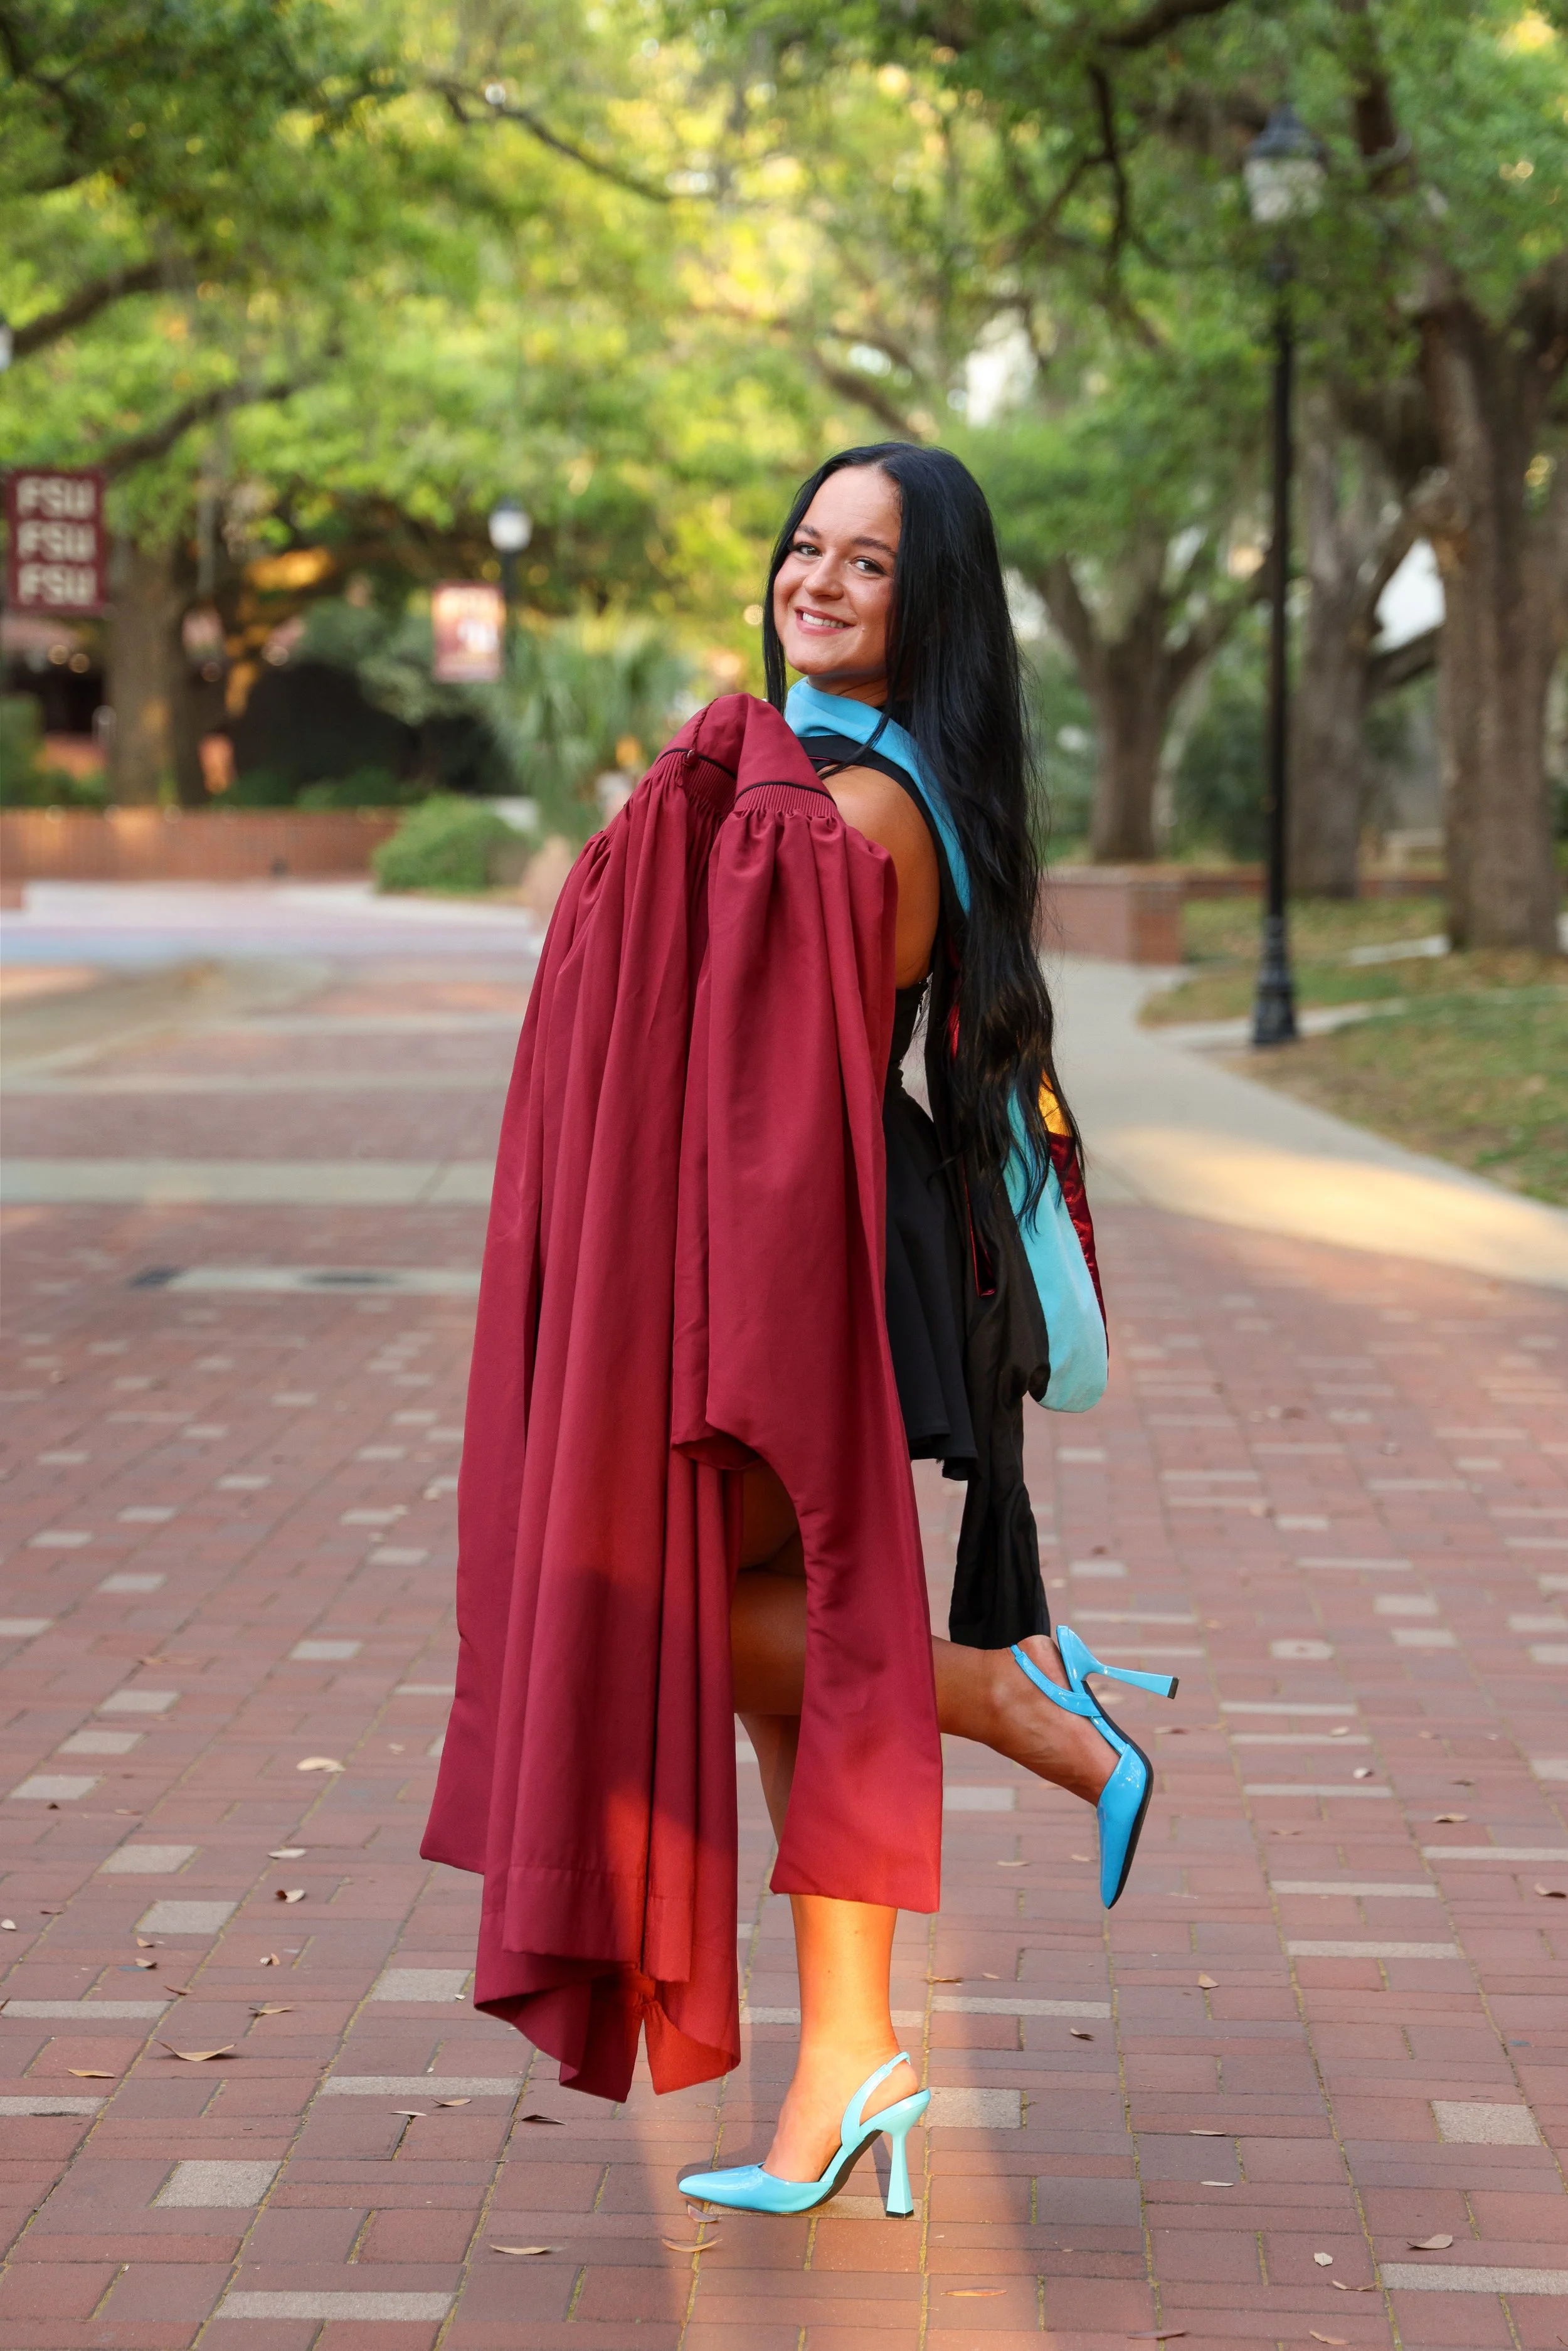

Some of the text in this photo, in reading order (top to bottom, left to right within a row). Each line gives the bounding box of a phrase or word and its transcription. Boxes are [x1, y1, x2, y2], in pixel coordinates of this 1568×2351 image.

[18, 477, 95, 517] FSU
[18, 521, 96, 560] FSU
[19, 565, 96, 605] FSU
